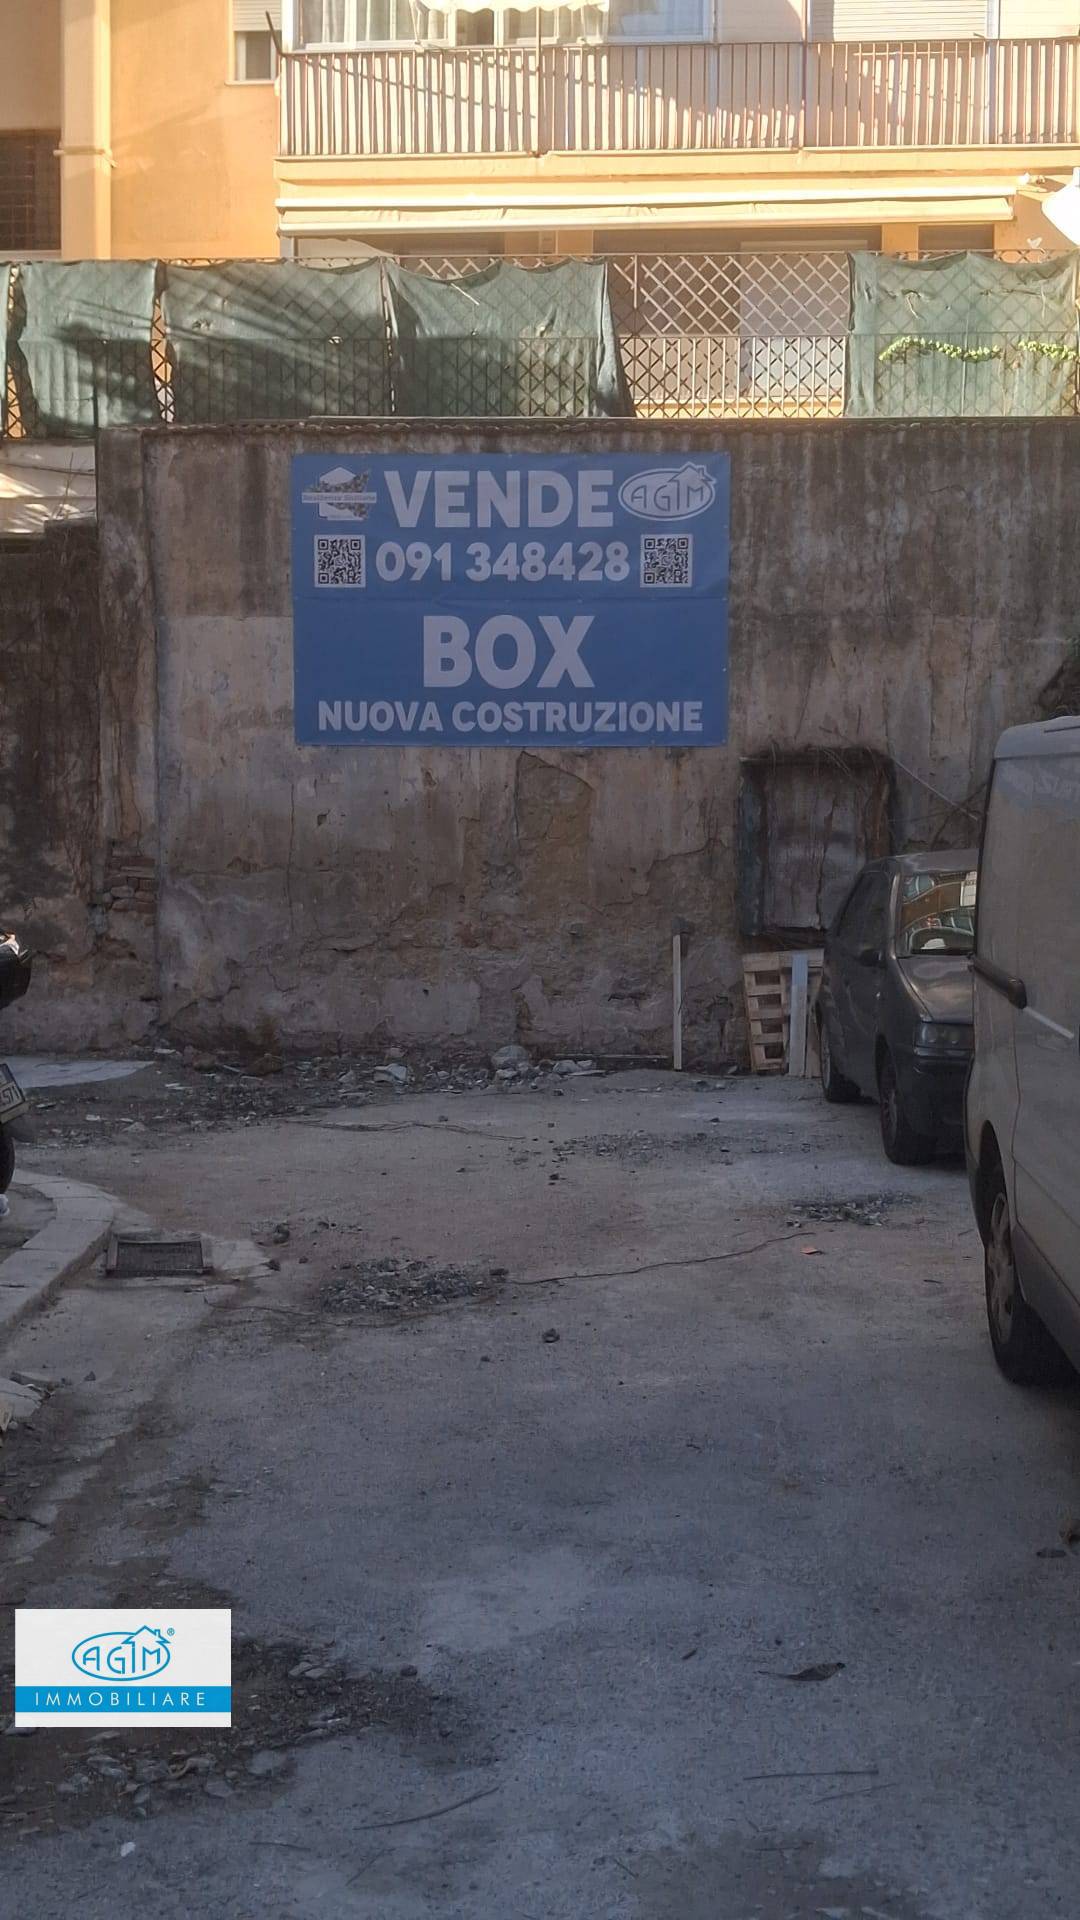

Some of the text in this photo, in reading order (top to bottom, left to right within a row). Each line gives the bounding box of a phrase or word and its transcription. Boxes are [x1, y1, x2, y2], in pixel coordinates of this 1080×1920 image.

[383, 470, 614, 528] VENDE
[630, 480, 704, 512] AGIM
[375, 541, 630, 582] 091 348428
[423, 614, 595, 689] BOX
[318, 701, 703, 732] NUOVA COSTRUZIONE
